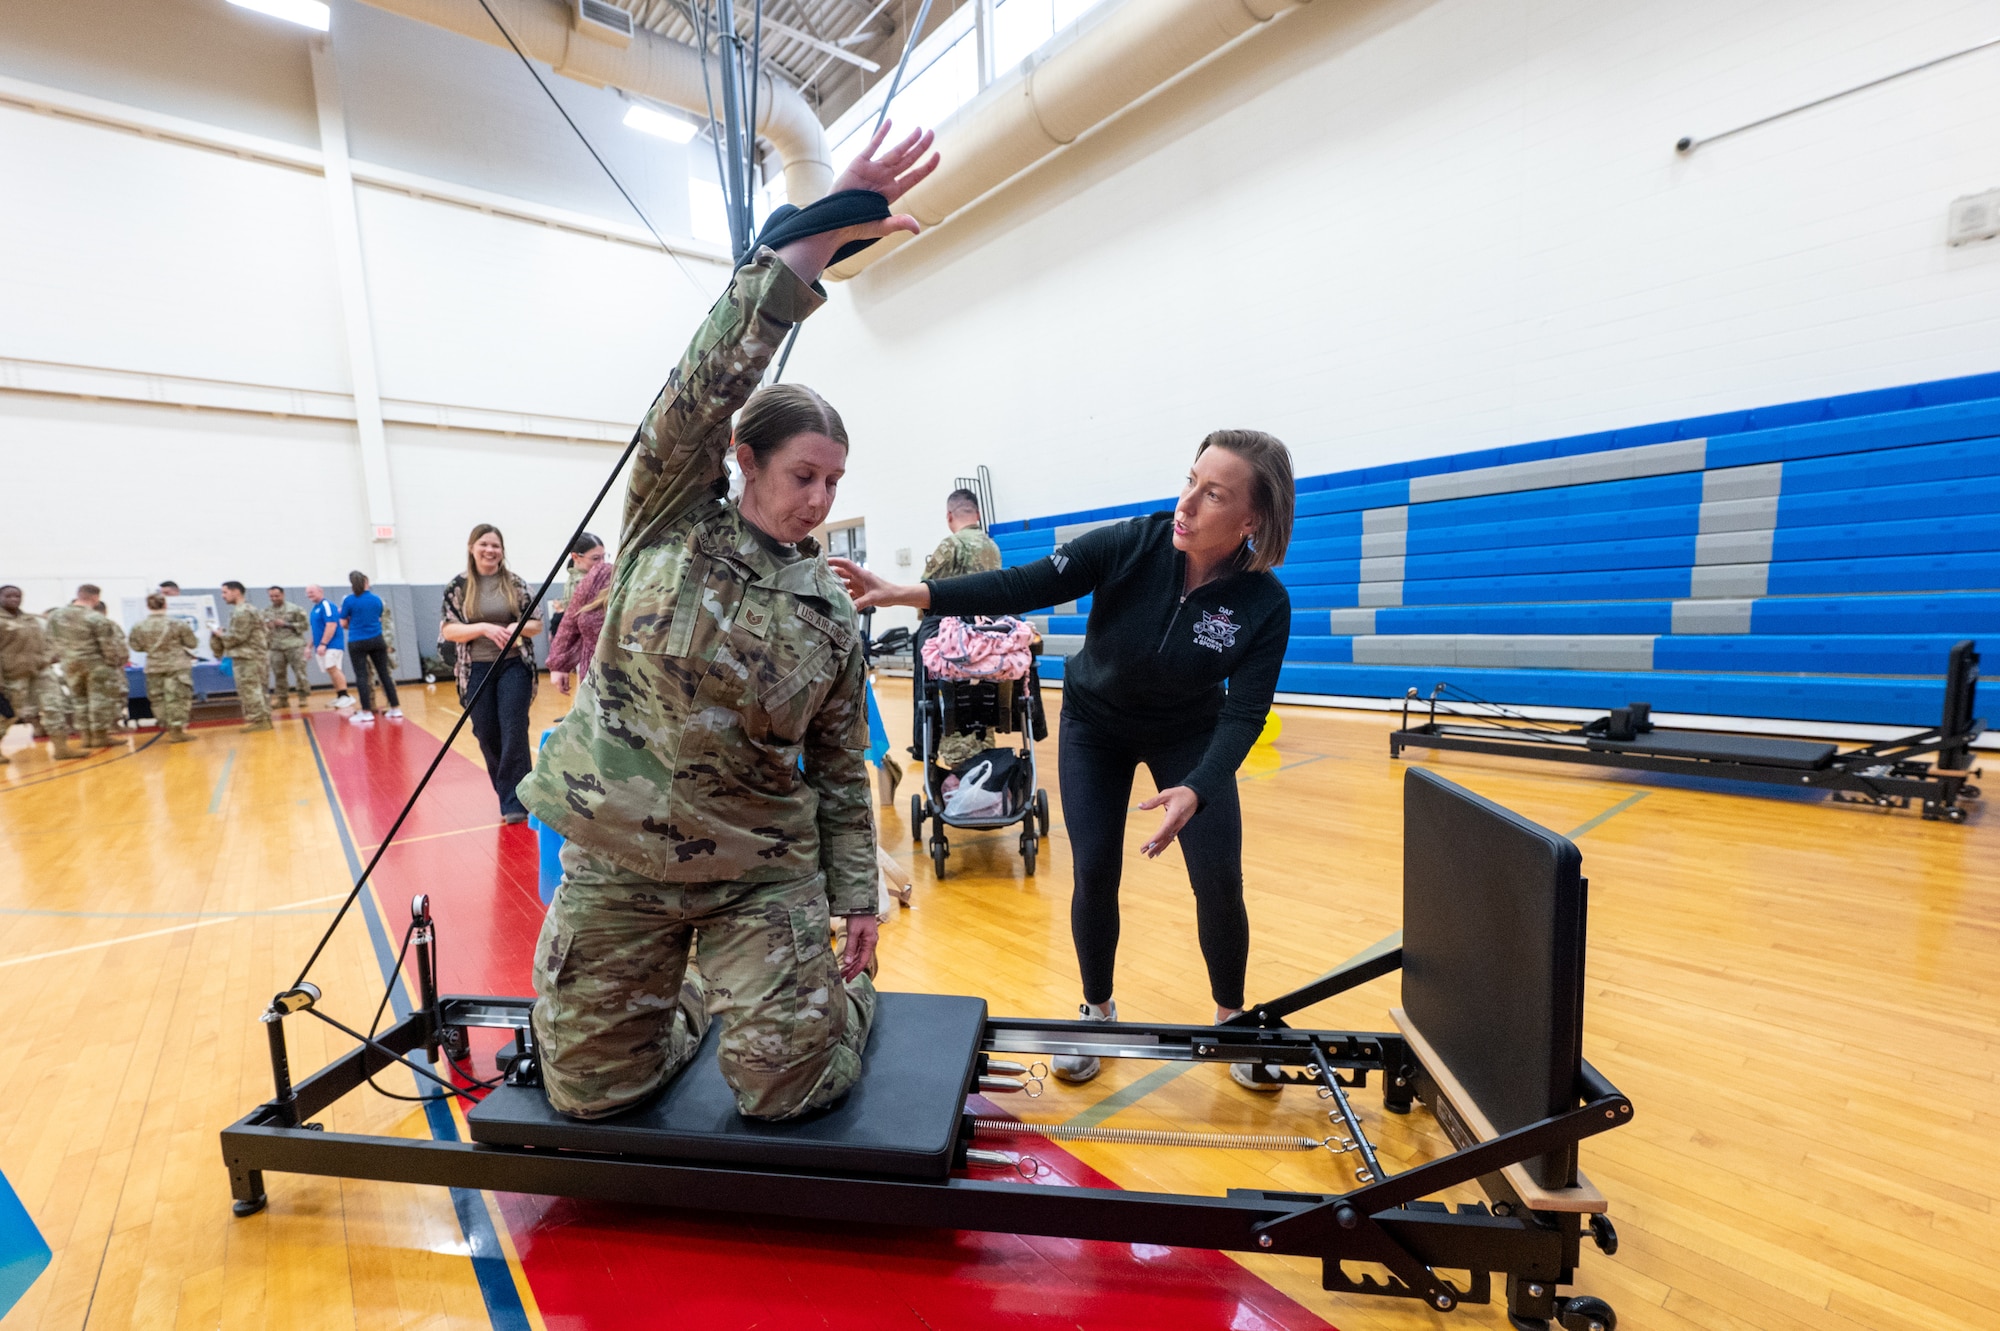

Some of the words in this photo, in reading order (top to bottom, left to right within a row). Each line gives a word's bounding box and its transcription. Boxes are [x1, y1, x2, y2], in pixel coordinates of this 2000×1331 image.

[1218, 606, 1234, 616] DAF
[815, 617, 829, 631] AIR
[830, 625, 851, 647] FORCE
[1199, 639, 1223, 653] SPORTS
